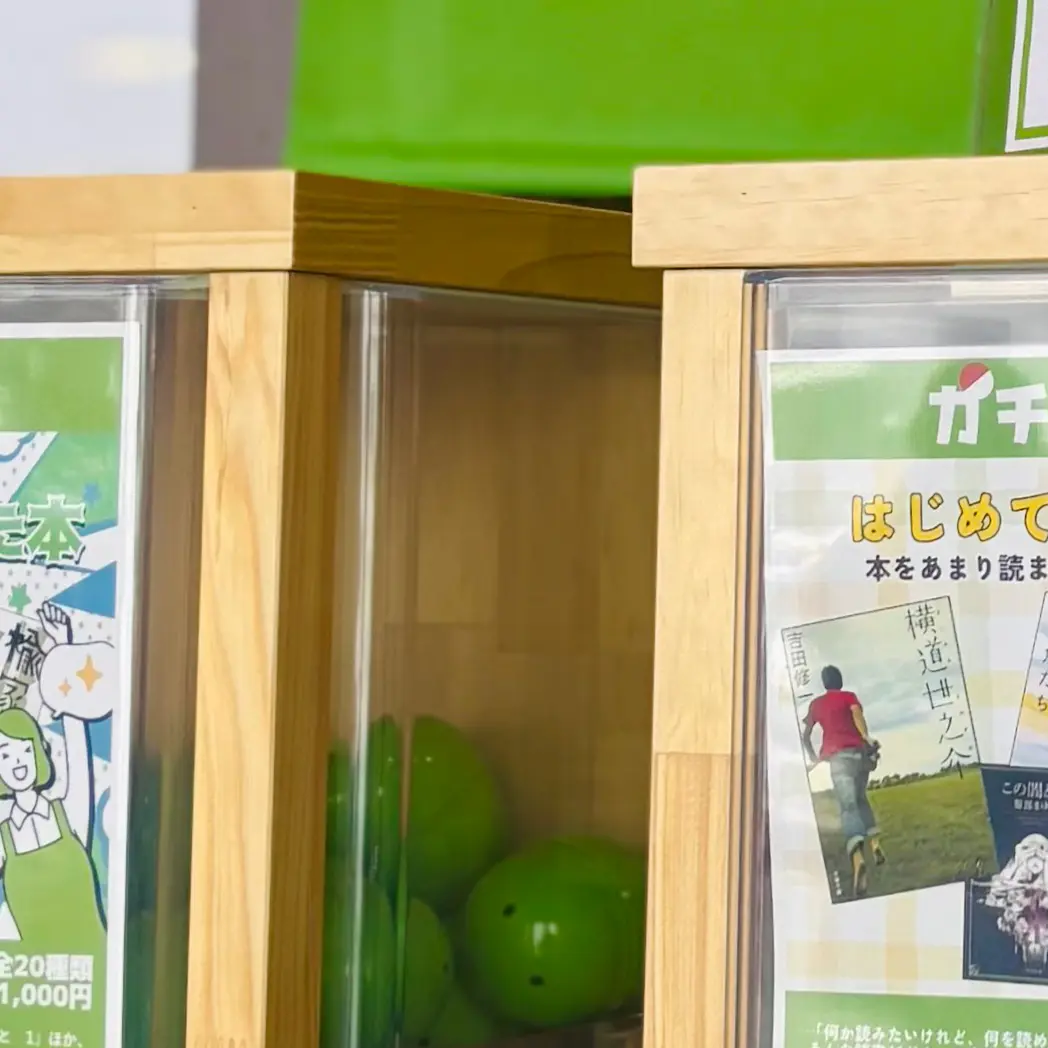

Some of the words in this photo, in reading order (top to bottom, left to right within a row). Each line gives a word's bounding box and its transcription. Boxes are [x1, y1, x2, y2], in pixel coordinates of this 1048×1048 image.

[904, 602, 973, 780] 横道世之介
